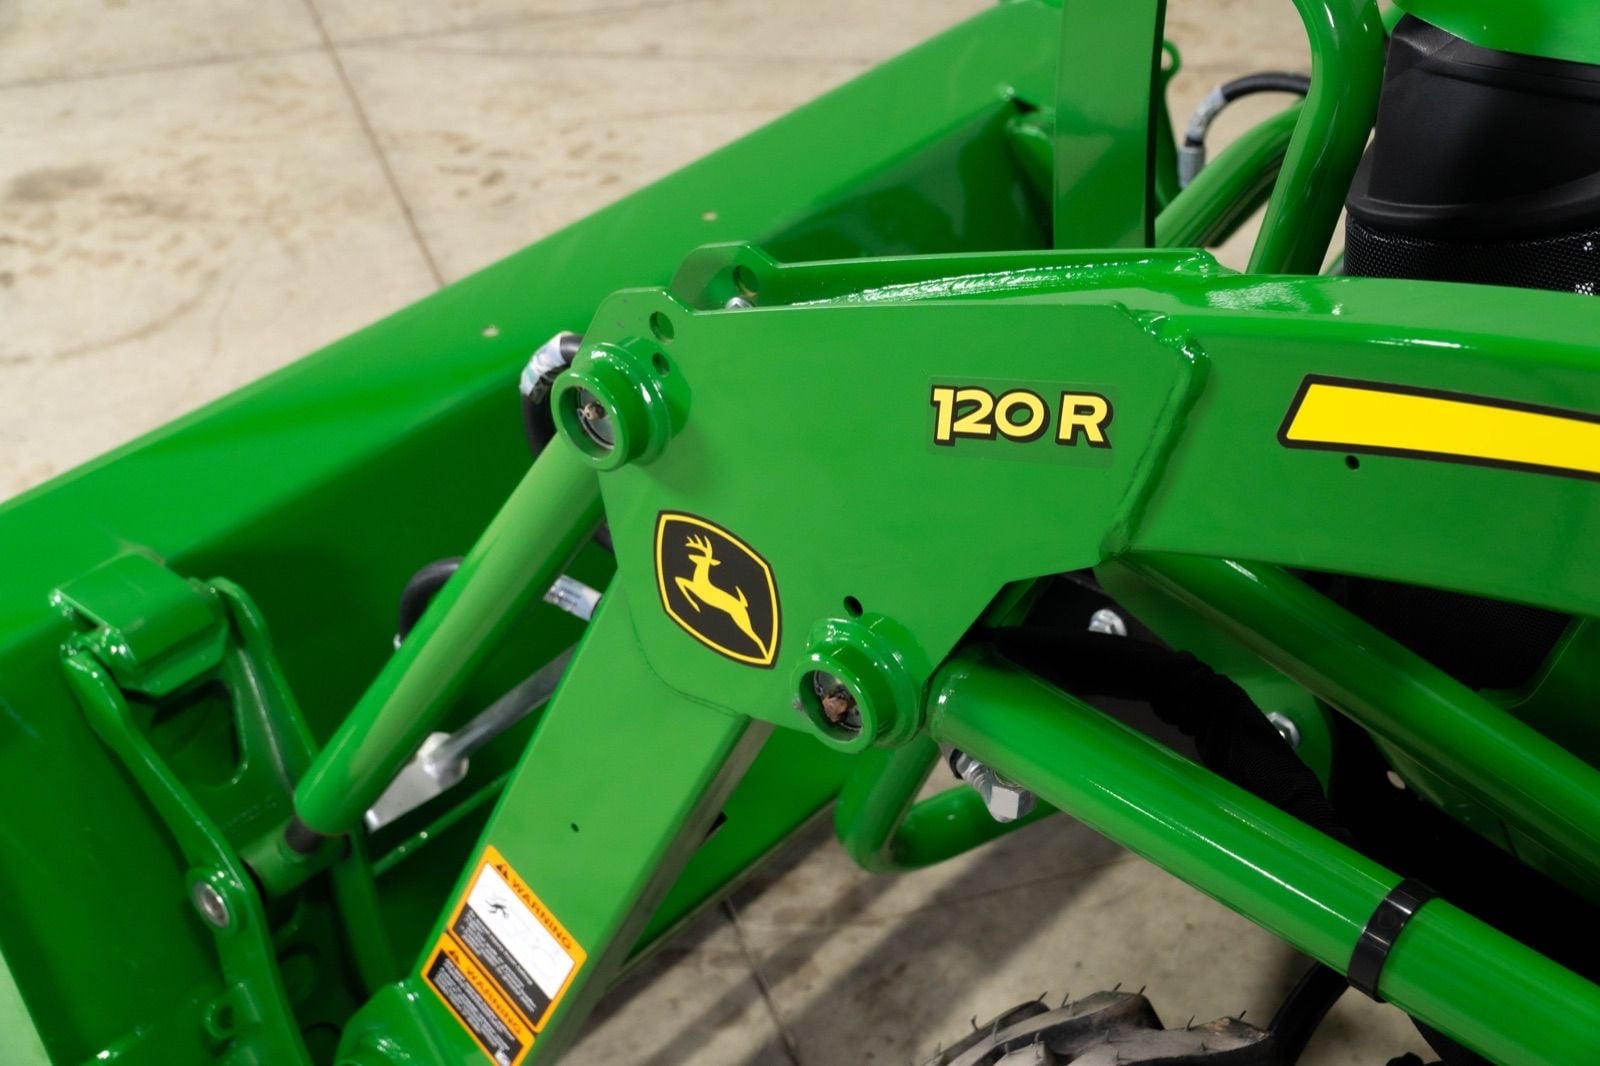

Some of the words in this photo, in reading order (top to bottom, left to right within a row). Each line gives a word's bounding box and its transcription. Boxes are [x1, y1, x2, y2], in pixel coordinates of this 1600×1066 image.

[930, 385, 1051, 446] 120
[1055, 391, 1113, 449] R
[512, 878, 572, 950] WARNING
[466, 967, 521, 1034] WARNING
